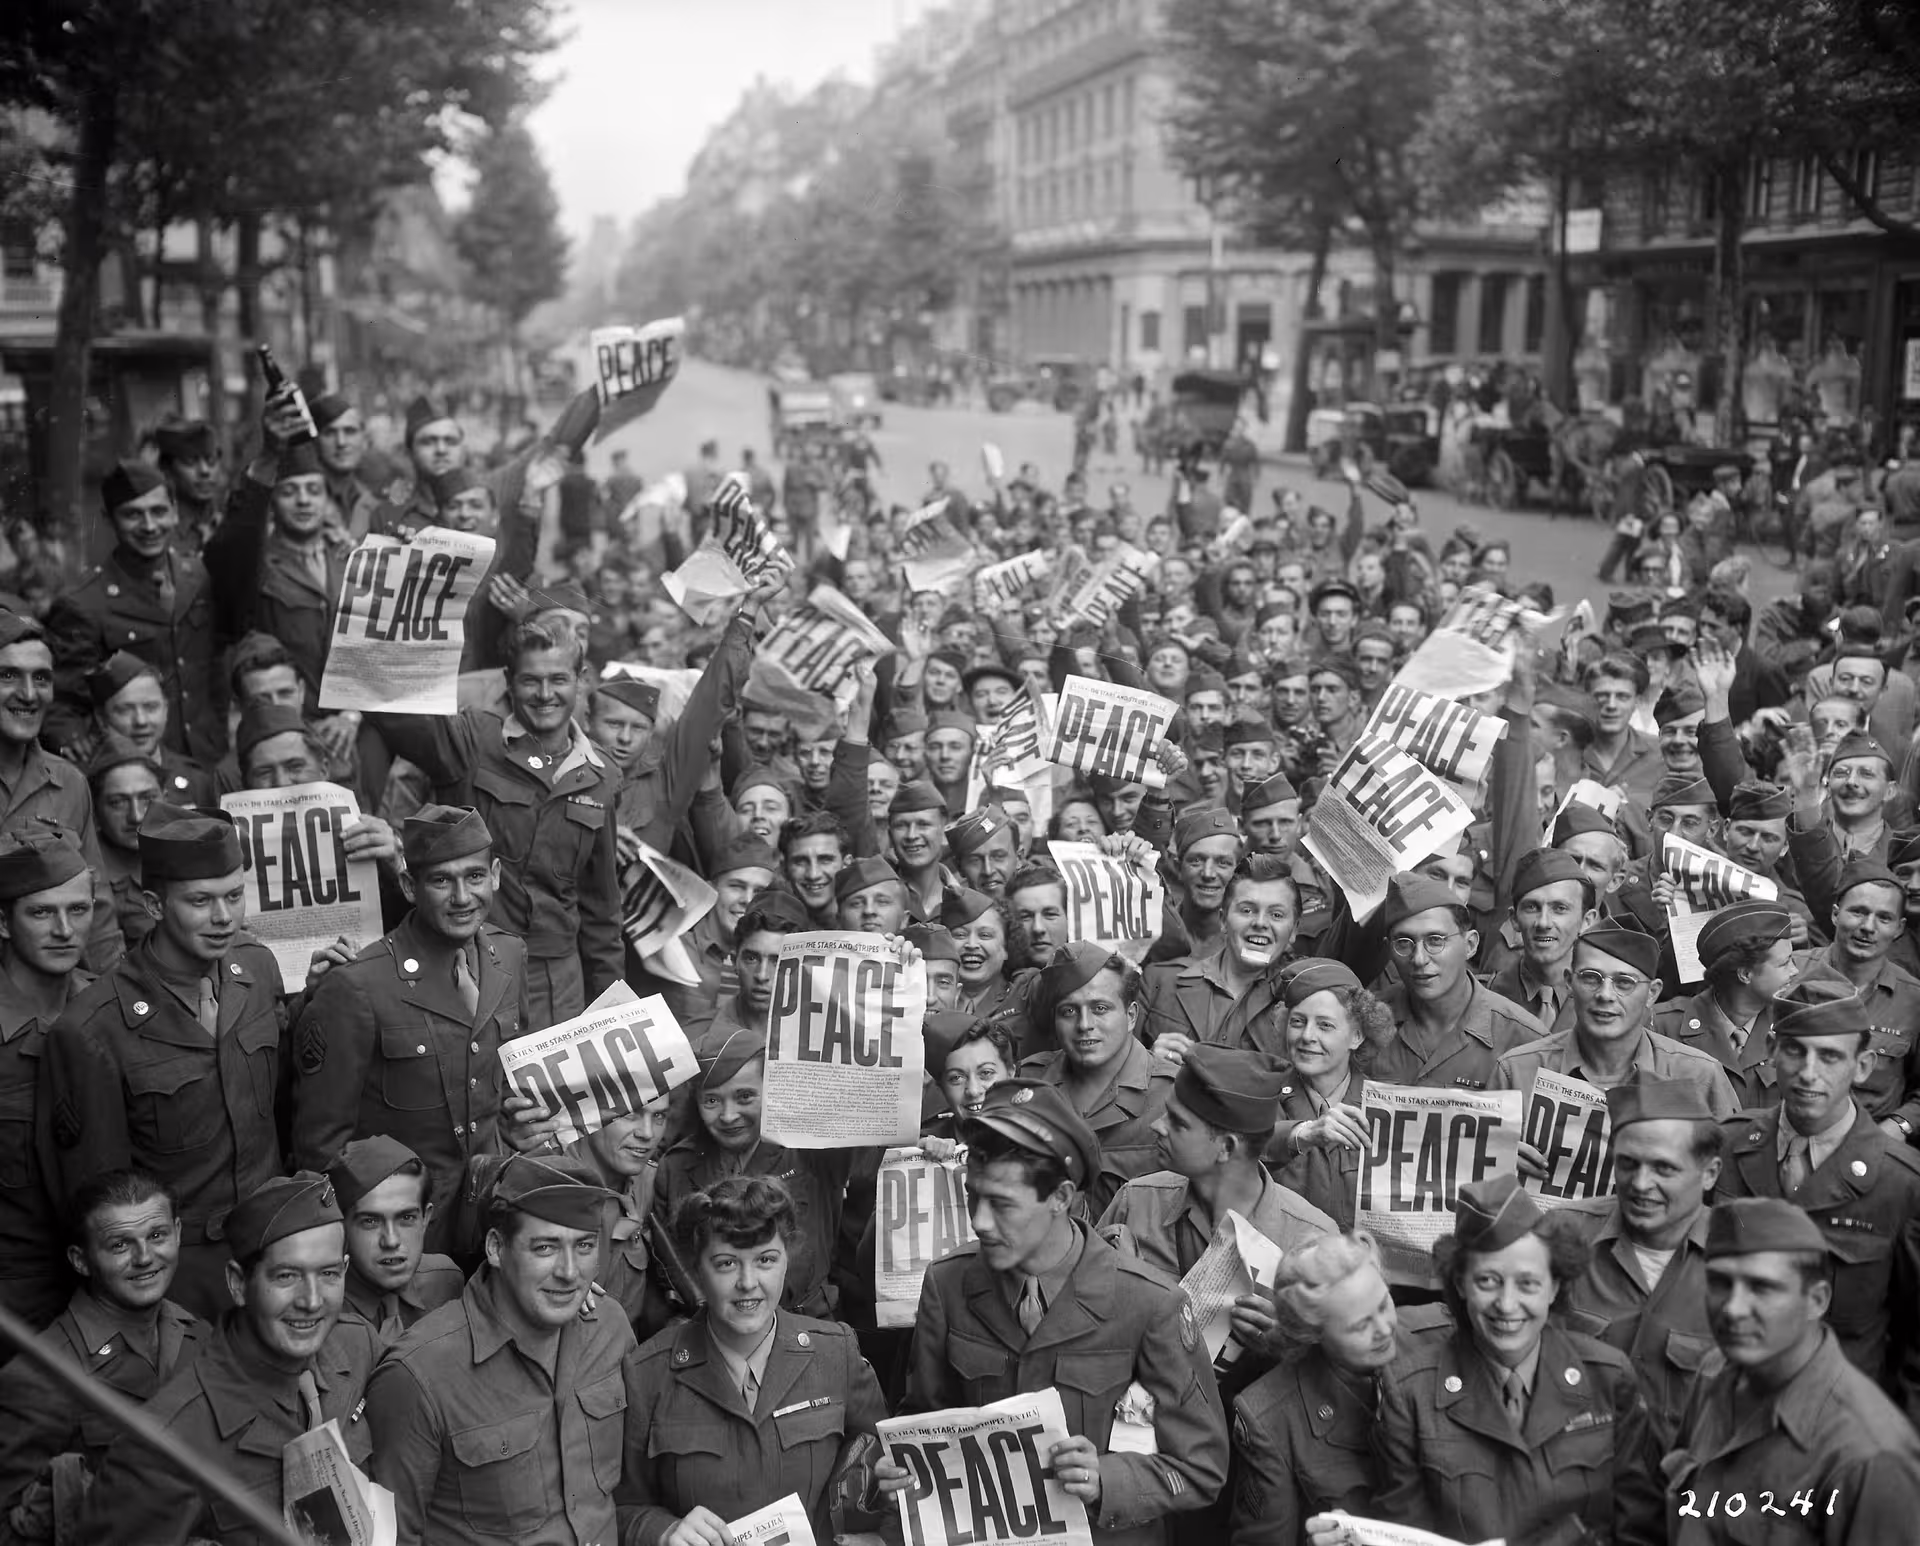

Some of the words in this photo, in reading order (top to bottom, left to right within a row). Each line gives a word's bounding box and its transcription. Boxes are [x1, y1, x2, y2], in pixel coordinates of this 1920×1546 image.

[598, 336, 674, 406] PEACE
[338, 547, 473, 641] PEACE
[1051, 694, 1164, 784] PEACE
[1370, 684, 1481, 784] PEACE
[1330, 733, 1455, 853] PEACE
[233, 806, 361, 912] PEACE
[1062, 859, 1152, 940] PEACE
[806, 941, 816, 949] THE
[817, 941, 837, 949] STARS
[838, 943, 853, 951] AND
[854, 944, 879, 953] STRIPES
[507, 1048, 533, 1062] EXTRA
[535, 1042, 549, 1051] THE
[550, 1032, 572, 1046] STARS
[573, 1026, 589, 1038] AND
[589, 1016, 617, 1031] STRIPES
[768, 955, 904, 1068] PEACE
[512, 1018, 674, 1137] PEACE
[1366, 1090, 1391, 1101] EXTRA
[1395, 1096, 1407, 1104] THE
[1408, 1097, 1429, 1106] STARS
[1431, 1098, 1446, 1107] AND
[1447, 1099, 1473, 1108] STRIPES
[1537, 1079, 1558, 1091] EXTRA
[1561, 1087, 1573, 1097] THE
[1573, 1090, 1594, 1102] STARS
[1360, 1106, 1502, 1213] PEACE
[1519, 1093, 1616, 1199] PEA
[917, 1428, 931, 1437] THE
[933, 1426, 956, 1436] STARS
[958, 1424, 974, 1434] AND
[974, 1417, 1005, 1430] STRIPES
[1009, 1408, 1038, 1423] EXTRA
[331, 1464, 342, 1487] Report
[890, 1424, 1066, 1546] PEACE
[733, 1531, 753, 1545] RIPES
[755, 1515, 783, 1534] EXTRA
